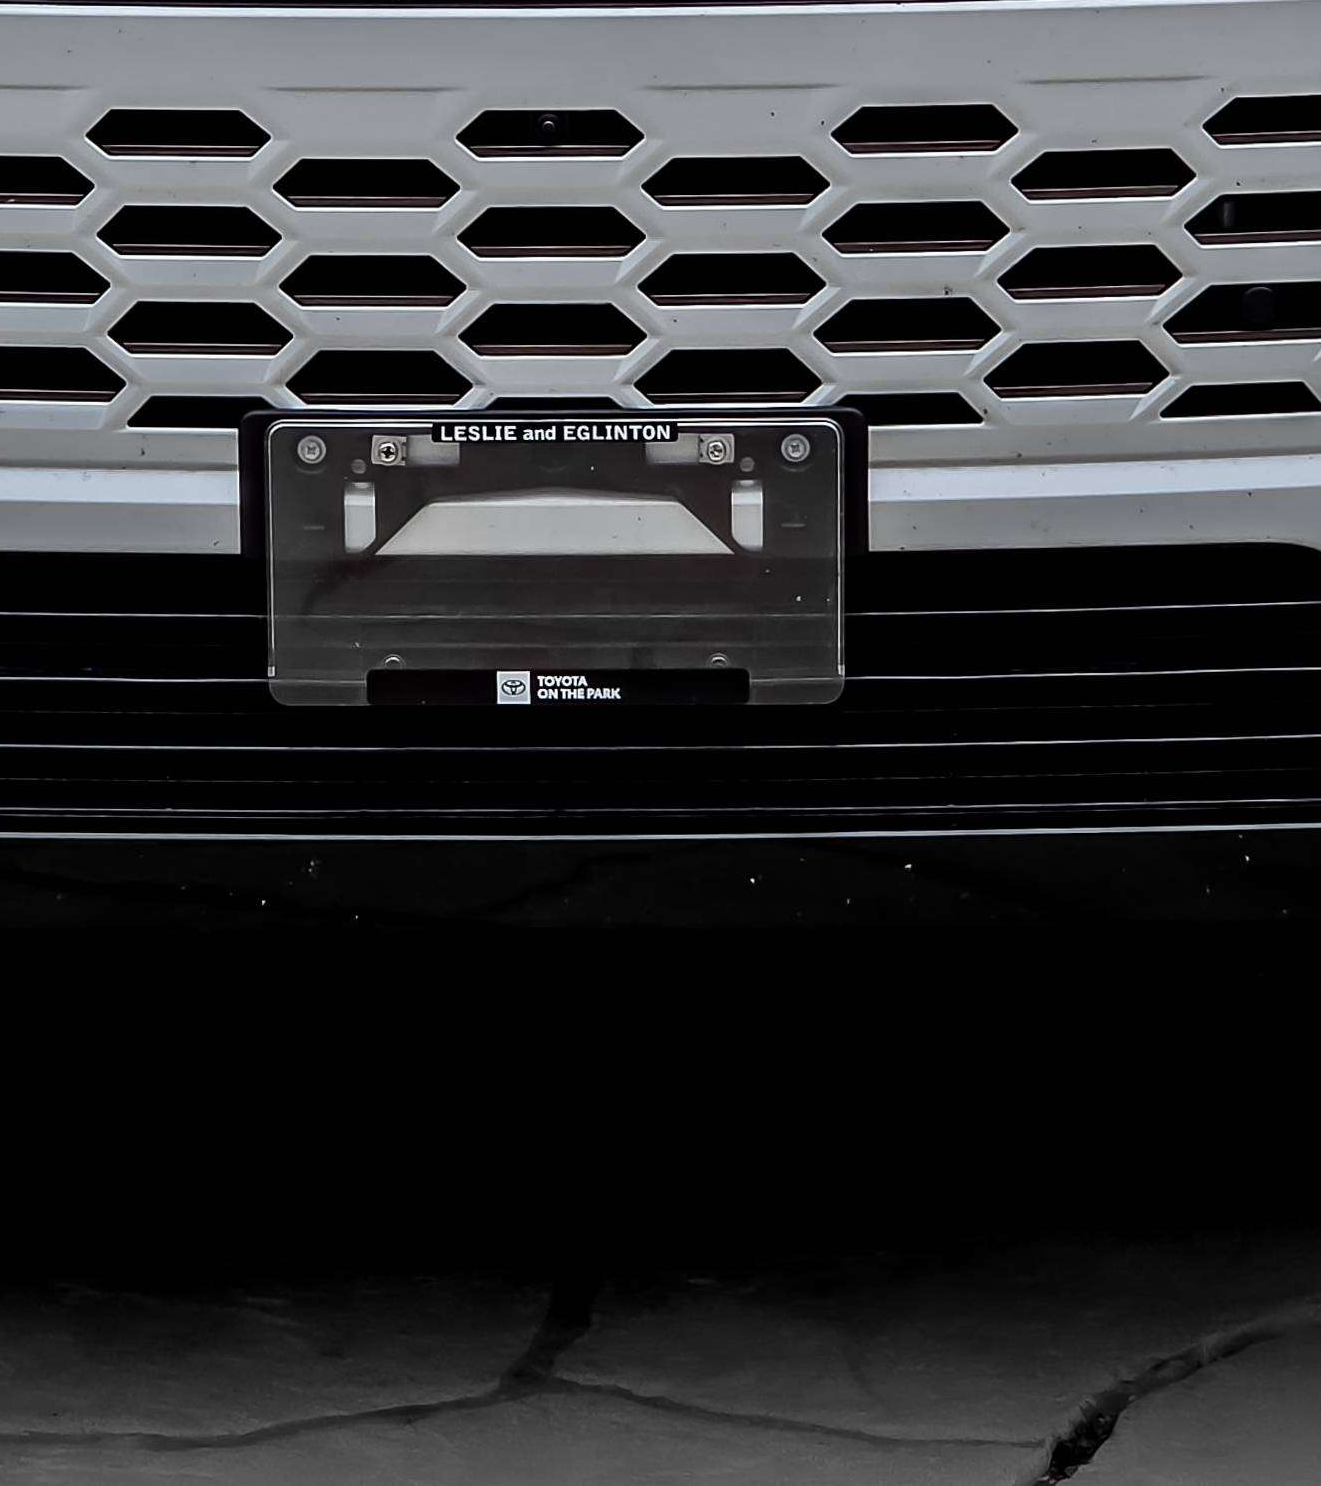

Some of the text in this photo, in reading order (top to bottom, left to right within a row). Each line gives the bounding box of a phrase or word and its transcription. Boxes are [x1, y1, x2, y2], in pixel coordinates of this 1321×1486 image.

[440, 425, 671, 441] LESLIE and EGLINTON
[537, 675, 588, 688] TOYOTA
[537, 687, 622, 700] ON THE PARK
